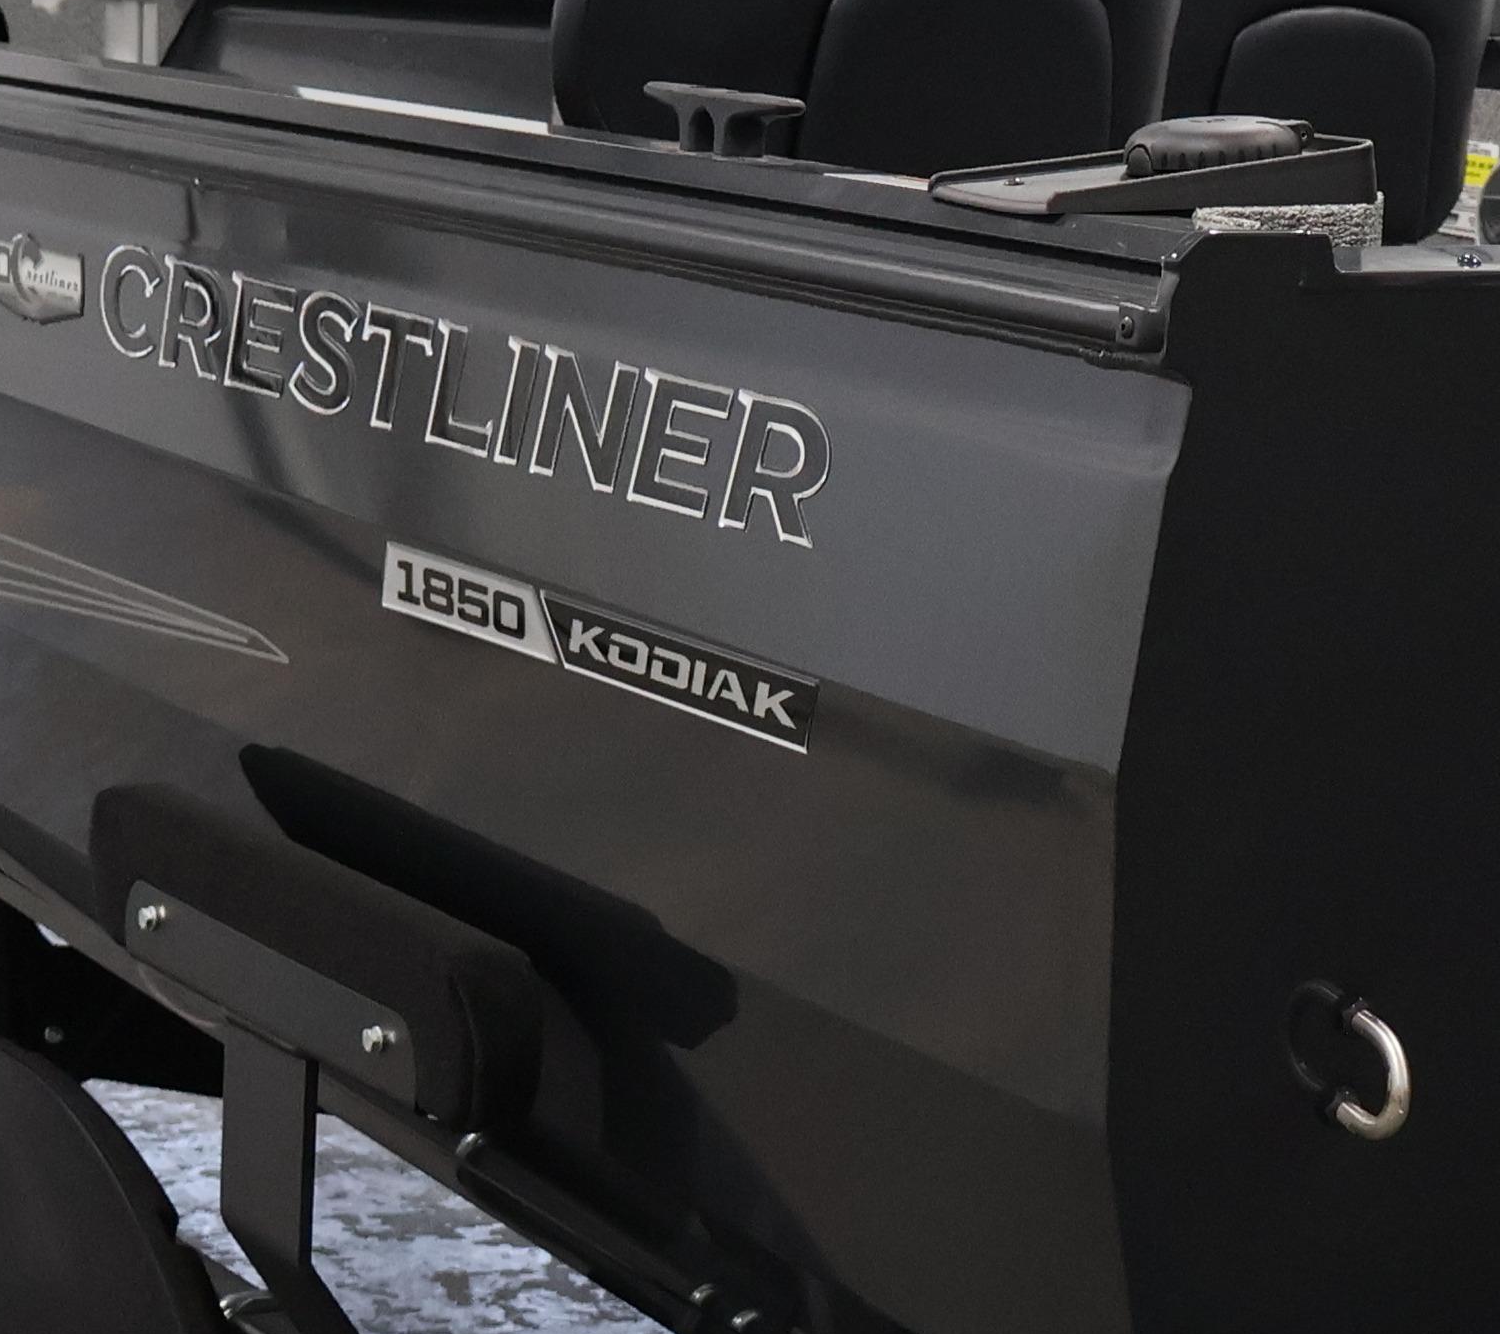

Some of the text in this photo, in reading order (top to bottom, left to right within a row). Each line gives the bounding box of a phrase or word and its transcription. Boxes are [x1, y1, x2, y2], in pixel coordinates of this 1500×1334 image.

[100, 244, 832, 548] CRESTLINER
[397, 560, 798, 730] 1850 KODIAK
